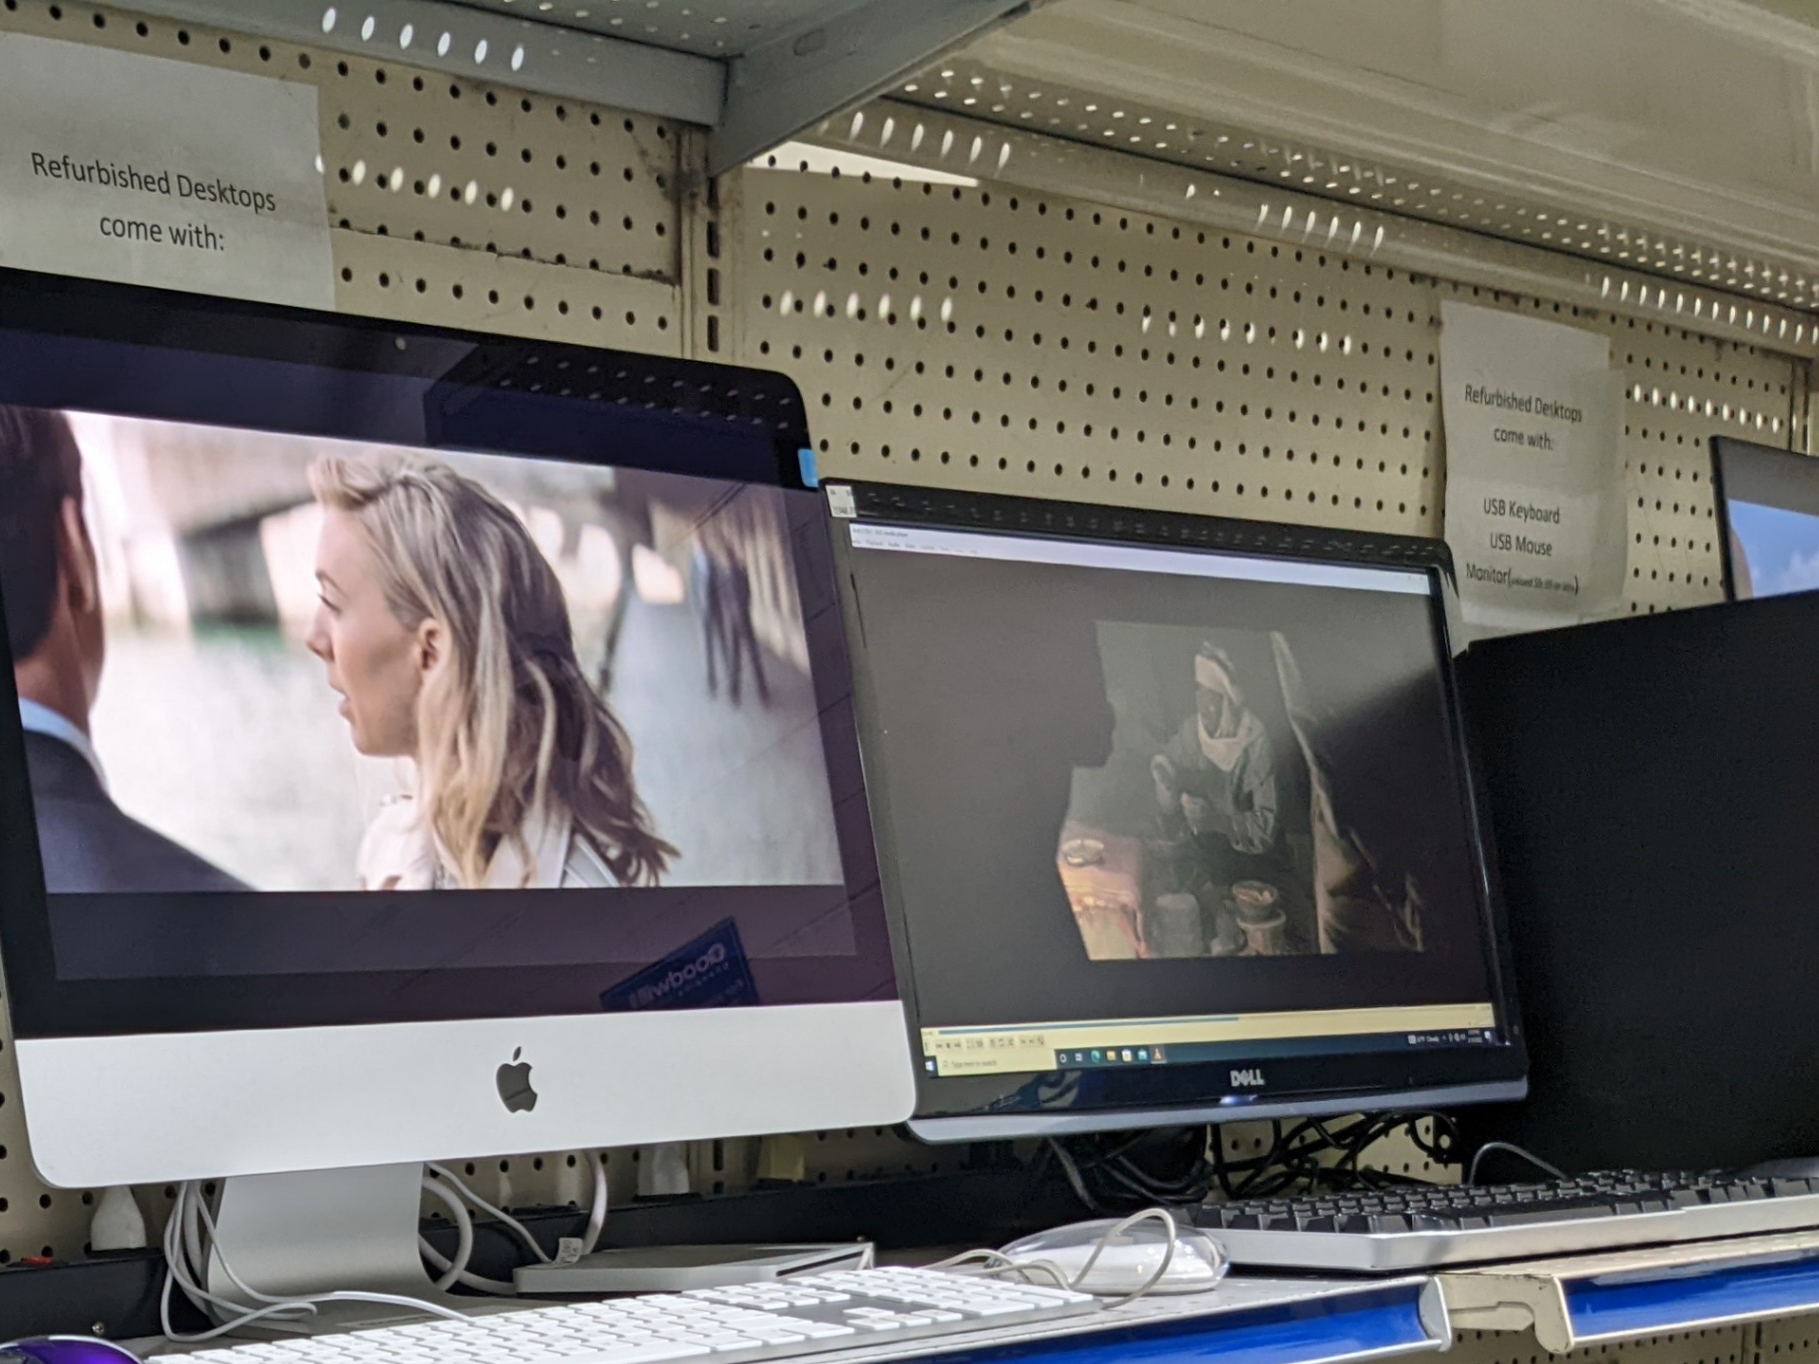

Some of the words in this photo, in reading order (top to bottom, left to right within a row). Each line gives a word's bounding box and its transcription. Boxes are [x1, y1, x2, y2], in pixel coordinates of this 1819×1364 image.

[31, 152, 170, 195] Refurbished
[177, 174, 276, 214] Desktops
[100, 216, 162, 243] come
[168, 222, 225, 251] with:
[1465, 384, 1532, 413] Refurbished
[1534, 397, 1582, 423] Desktops
[1494, 428, 1524, 446] come
[1527, 431, 1554, 450] with:
[1483, 498, 1506, 517] USB
[1509, 502, 1560, 525] Keyboard
[1490, 533, 1512, 551] USB
[1515, 536, 1552, 556] Mouse
[1230, 1069, 1264, 1087] DELL
